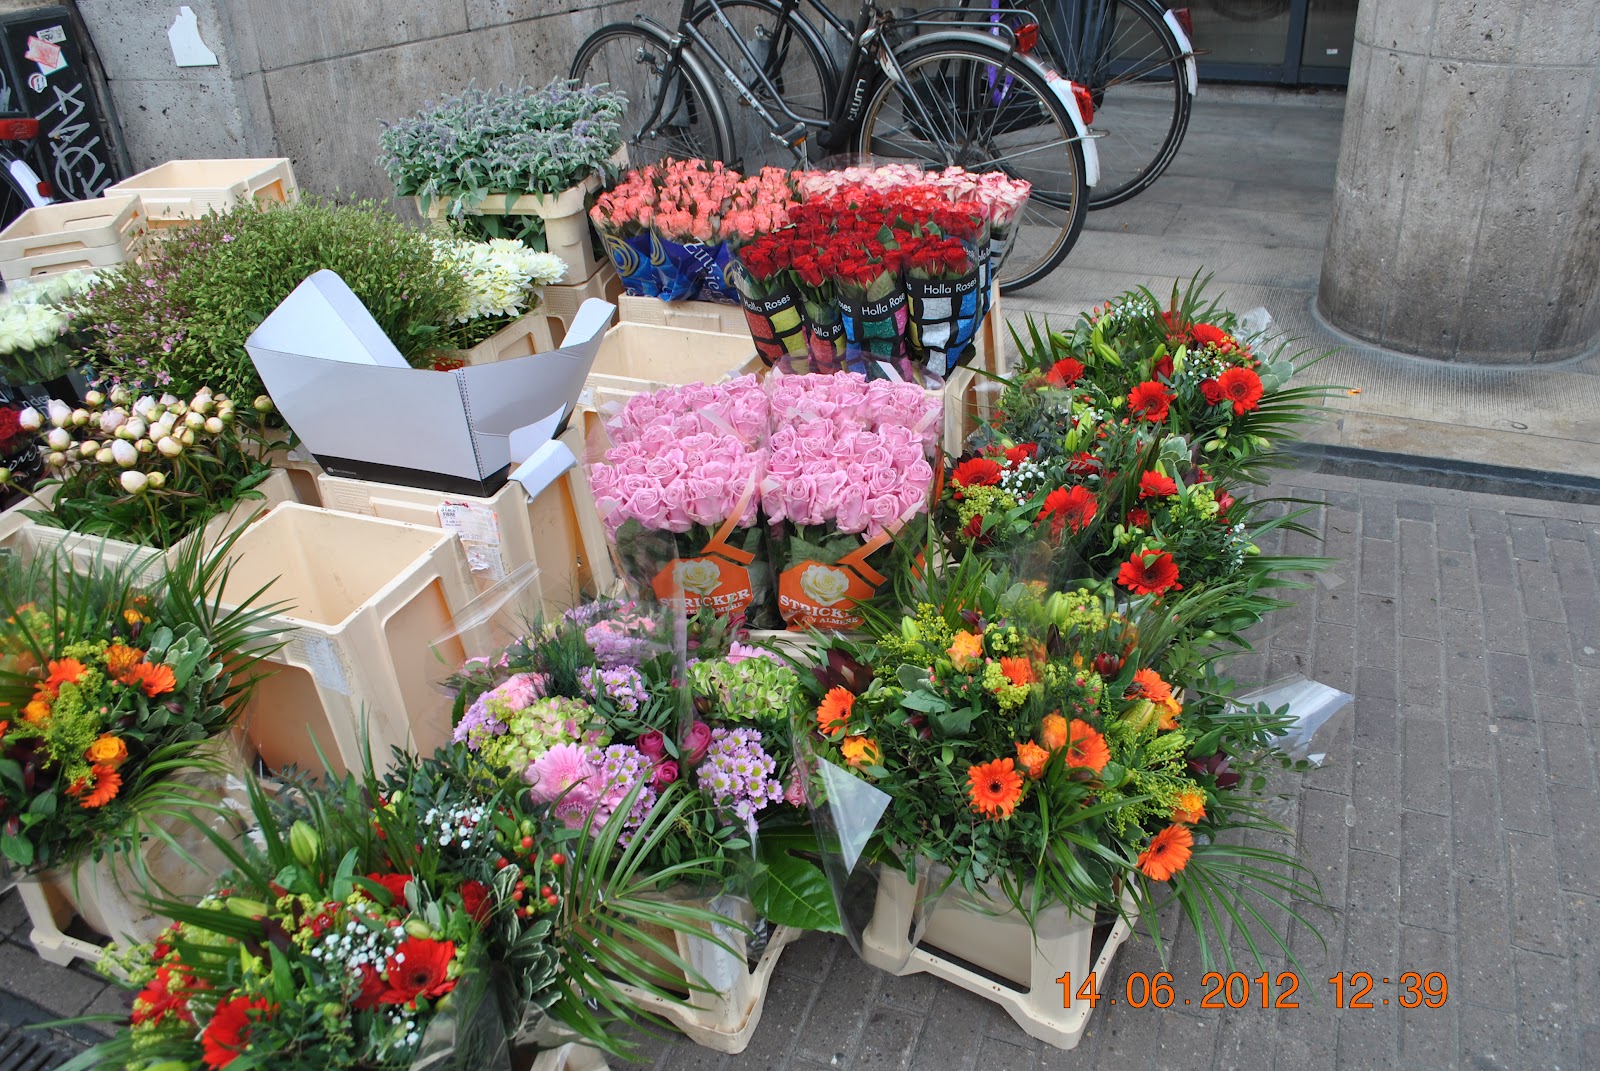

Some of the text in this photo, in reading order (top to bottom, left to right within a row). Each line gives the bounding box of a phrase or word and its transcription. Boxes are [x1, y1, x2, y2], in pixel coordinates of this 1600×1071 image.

[923, 284, 951, 294] Holla
[955, 277, 978, 293] Roses
[764, 294, 791, 312] Roses
[861, 303, 888, 316] Holla
[889, 292, 906, 309] Rose
[780, 594, 850, 619] STRICK
